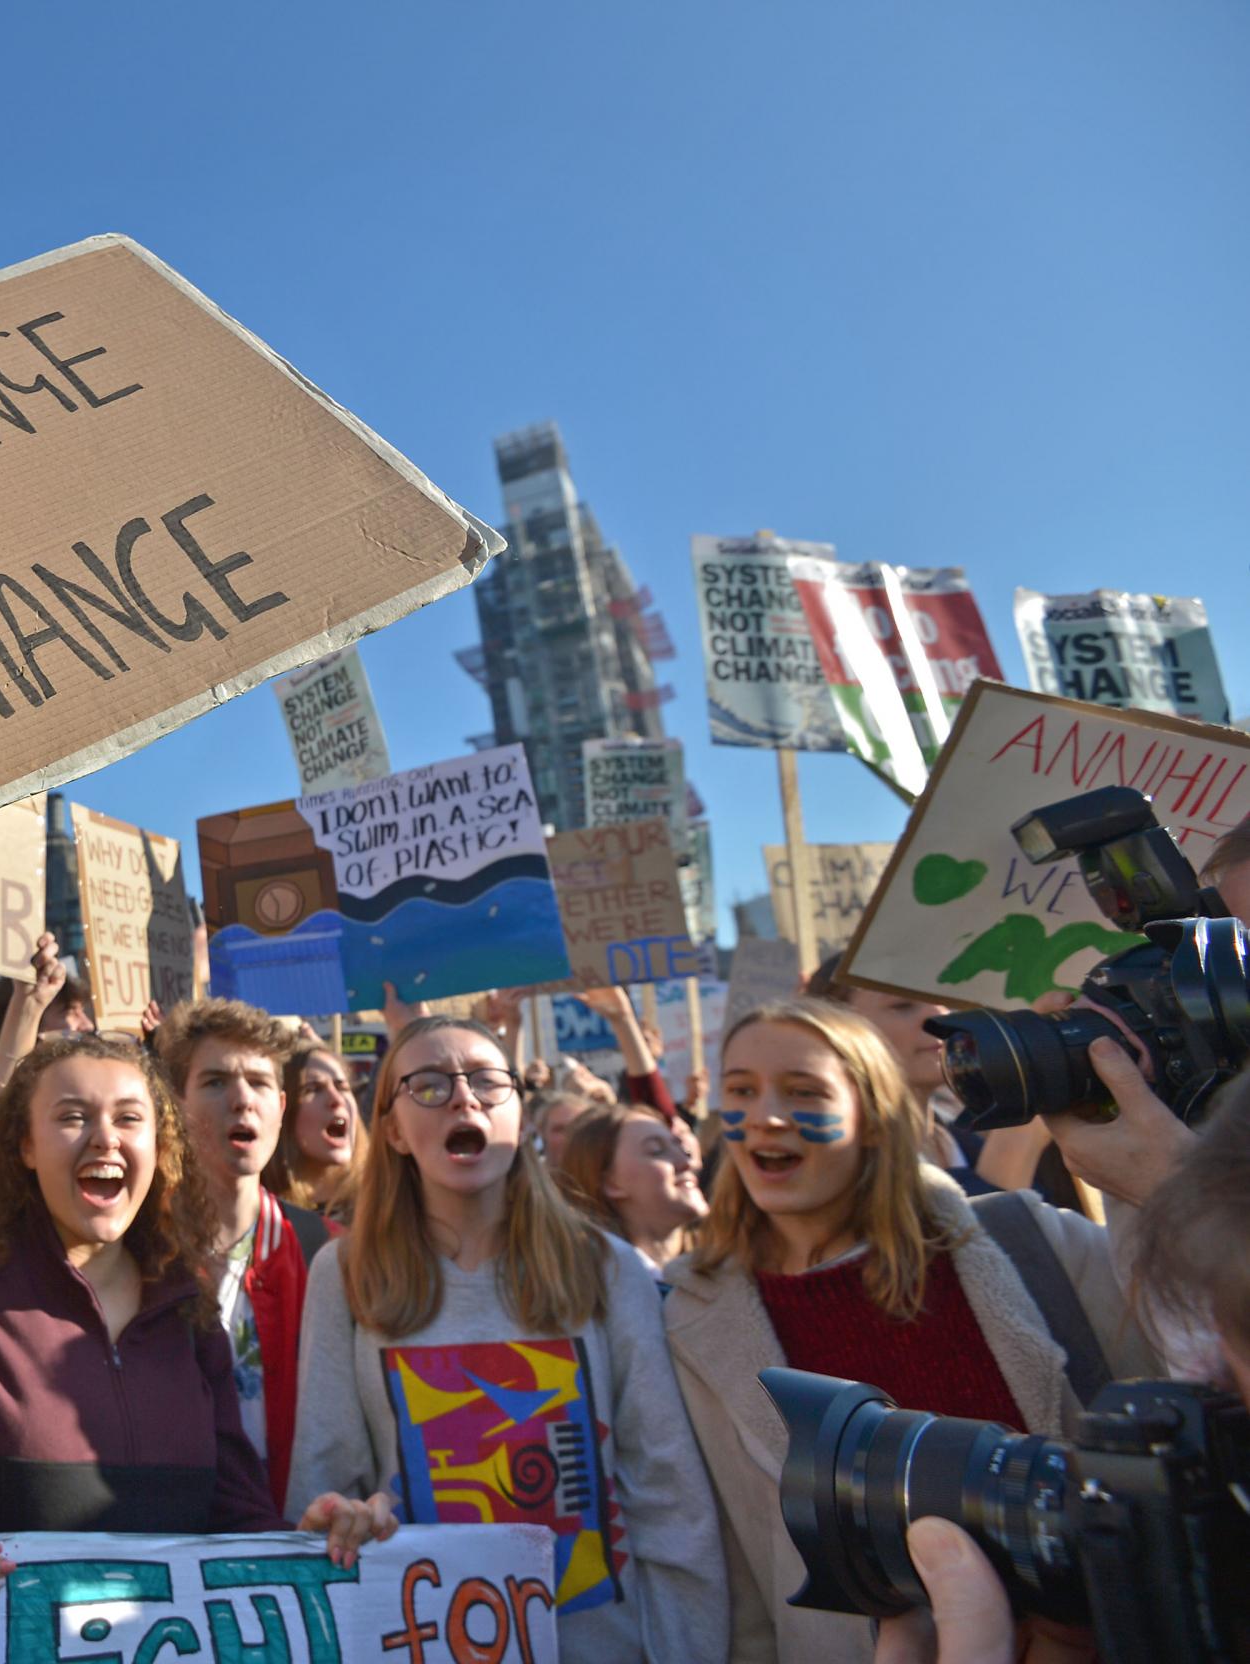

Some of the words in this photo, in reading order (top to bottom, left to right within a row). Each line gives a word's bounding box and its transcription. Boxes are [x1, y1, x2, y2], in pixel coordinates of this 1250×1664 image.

[703, 563, 791, 588] SYSTE
[705, 587, 802, 612] CHANG
[708, 611, 764, 633] NOT
[1028, 631, 1180, 668] SYSTEM
[284, 665, 351, 716] SYSTEM
[1037, 665, 1196, 704] CHANGE
[290, 681, 358, 731] CHANGE
[294, 720, 323, 749] NOT
[298, 716, 369, 765] CLIMATE
[989, 714, 1250, 828] ANNIHIL
[319, 810, 330, 836] I
[84, 832, 122, 871] WHY
[89, 876, 134, 915] NEED
[1, 877, 34, 970] B
[93, 916, 107, 945] IF
[112, 922, 133, 949] WE
[607, 934, 698, 985] DIE
[381, 1557, 553, 1664] for
